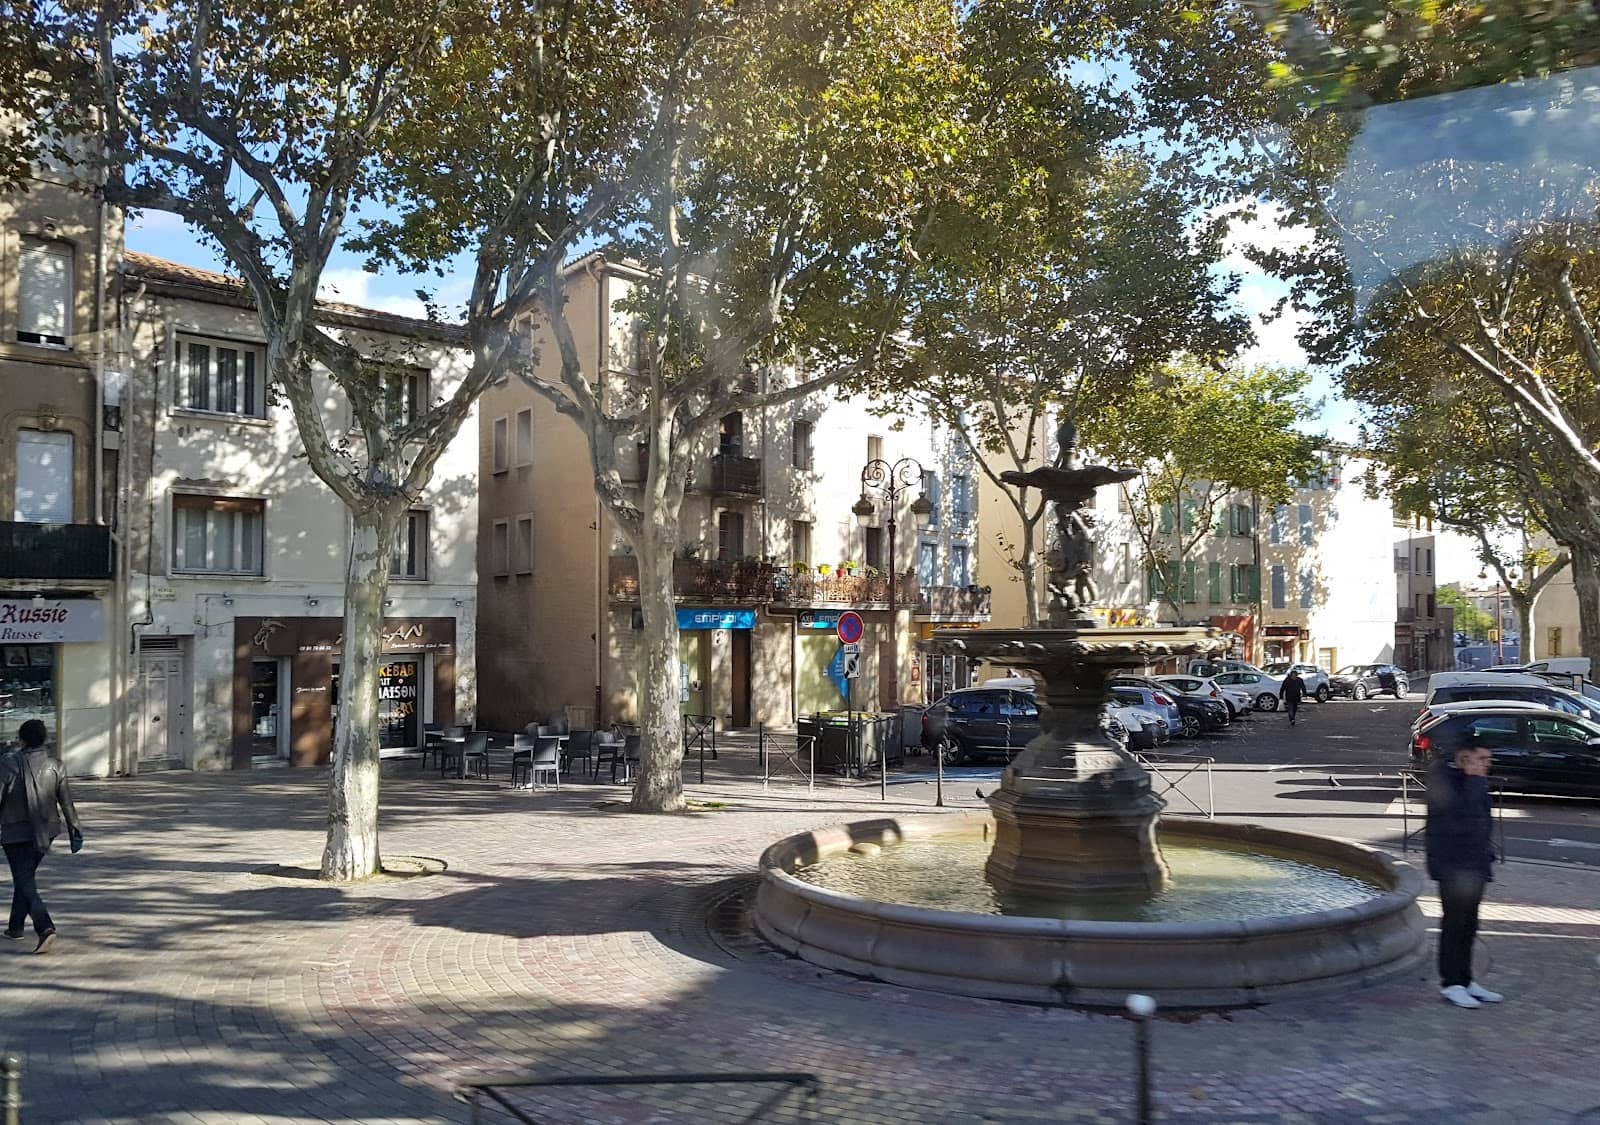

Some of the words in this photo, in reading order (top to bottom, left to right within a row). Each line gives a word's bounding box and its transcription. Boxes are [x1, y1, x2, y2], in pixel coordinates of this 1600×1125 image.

[0, 601, 68, 623] Russie
[1, 627, 42, 640] Russe
[379, 663, 414, 677] KEBAB
